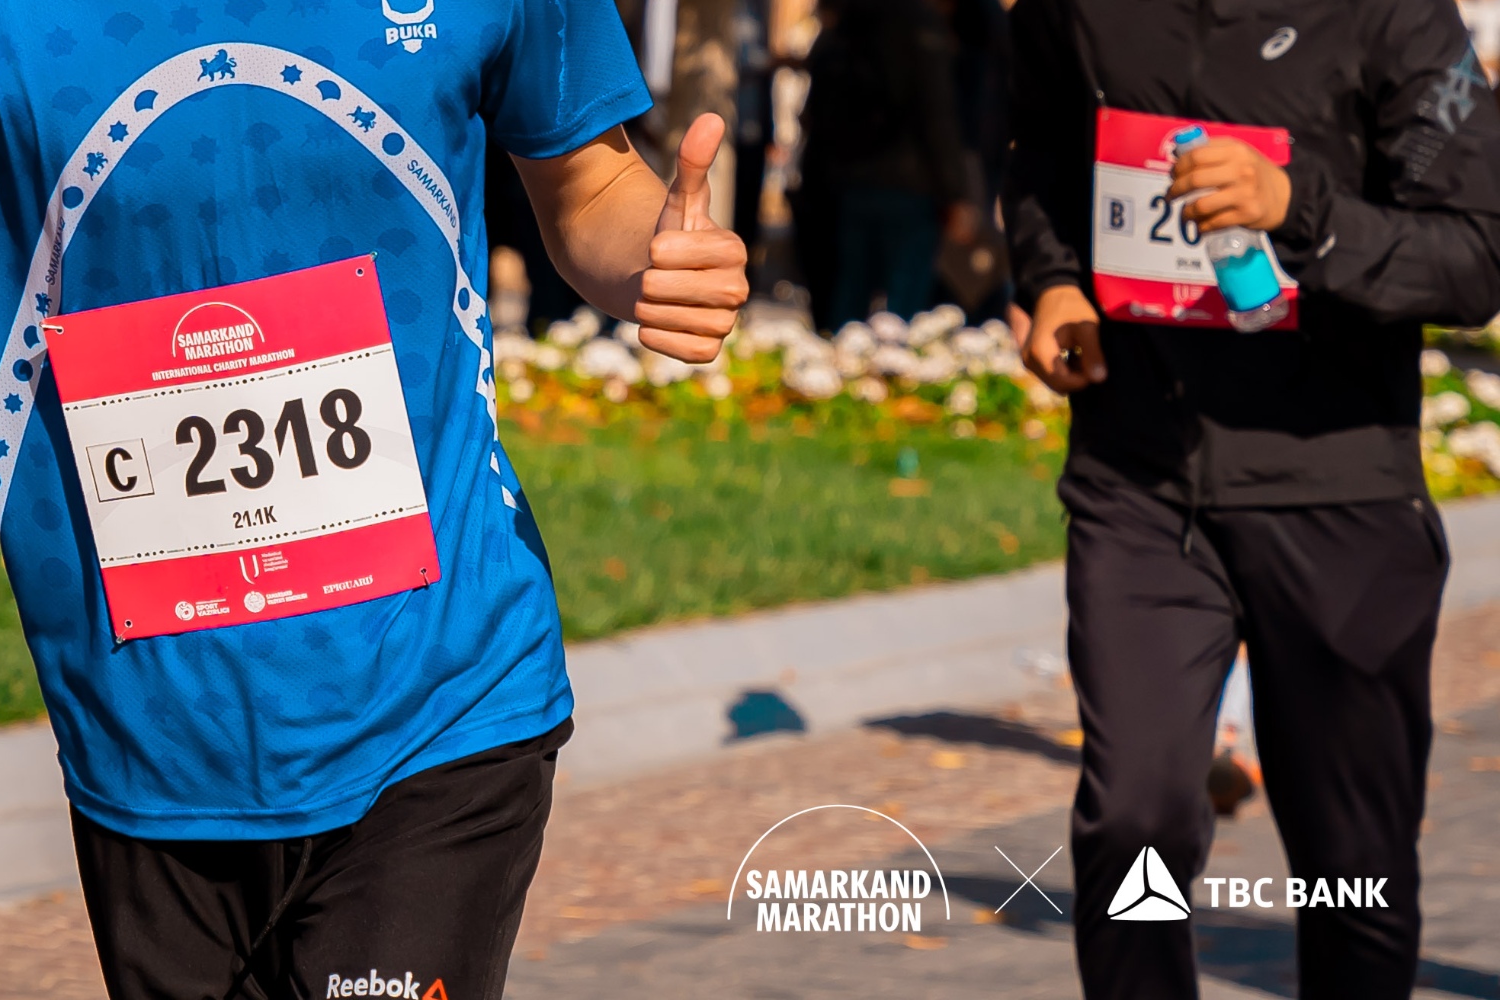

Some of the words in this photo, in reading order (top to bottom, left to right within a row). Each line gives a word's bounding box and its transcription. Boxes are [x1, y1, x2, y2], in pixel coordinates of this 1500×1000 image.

[385, 23, 438, 45] BUKA
[406, 159, 457, 229] SAMARKAND
[1110, 201, 1124, 230] B
[177, 323, 255, 348] SAMARKAND
[184, 337, 254, 360] MARATHON
[152, 364, 213, 381] INTERNATIONAL
[213, 358, 248, 372] CHARITY
[249, 348, 296, 367] MARATHON
[175, 388, 372, 498] 2318
[105, 447, 138, 493] C
[232, 505, 277, 529] 21.1K
[326, 968, 420, 1000] Reebok
